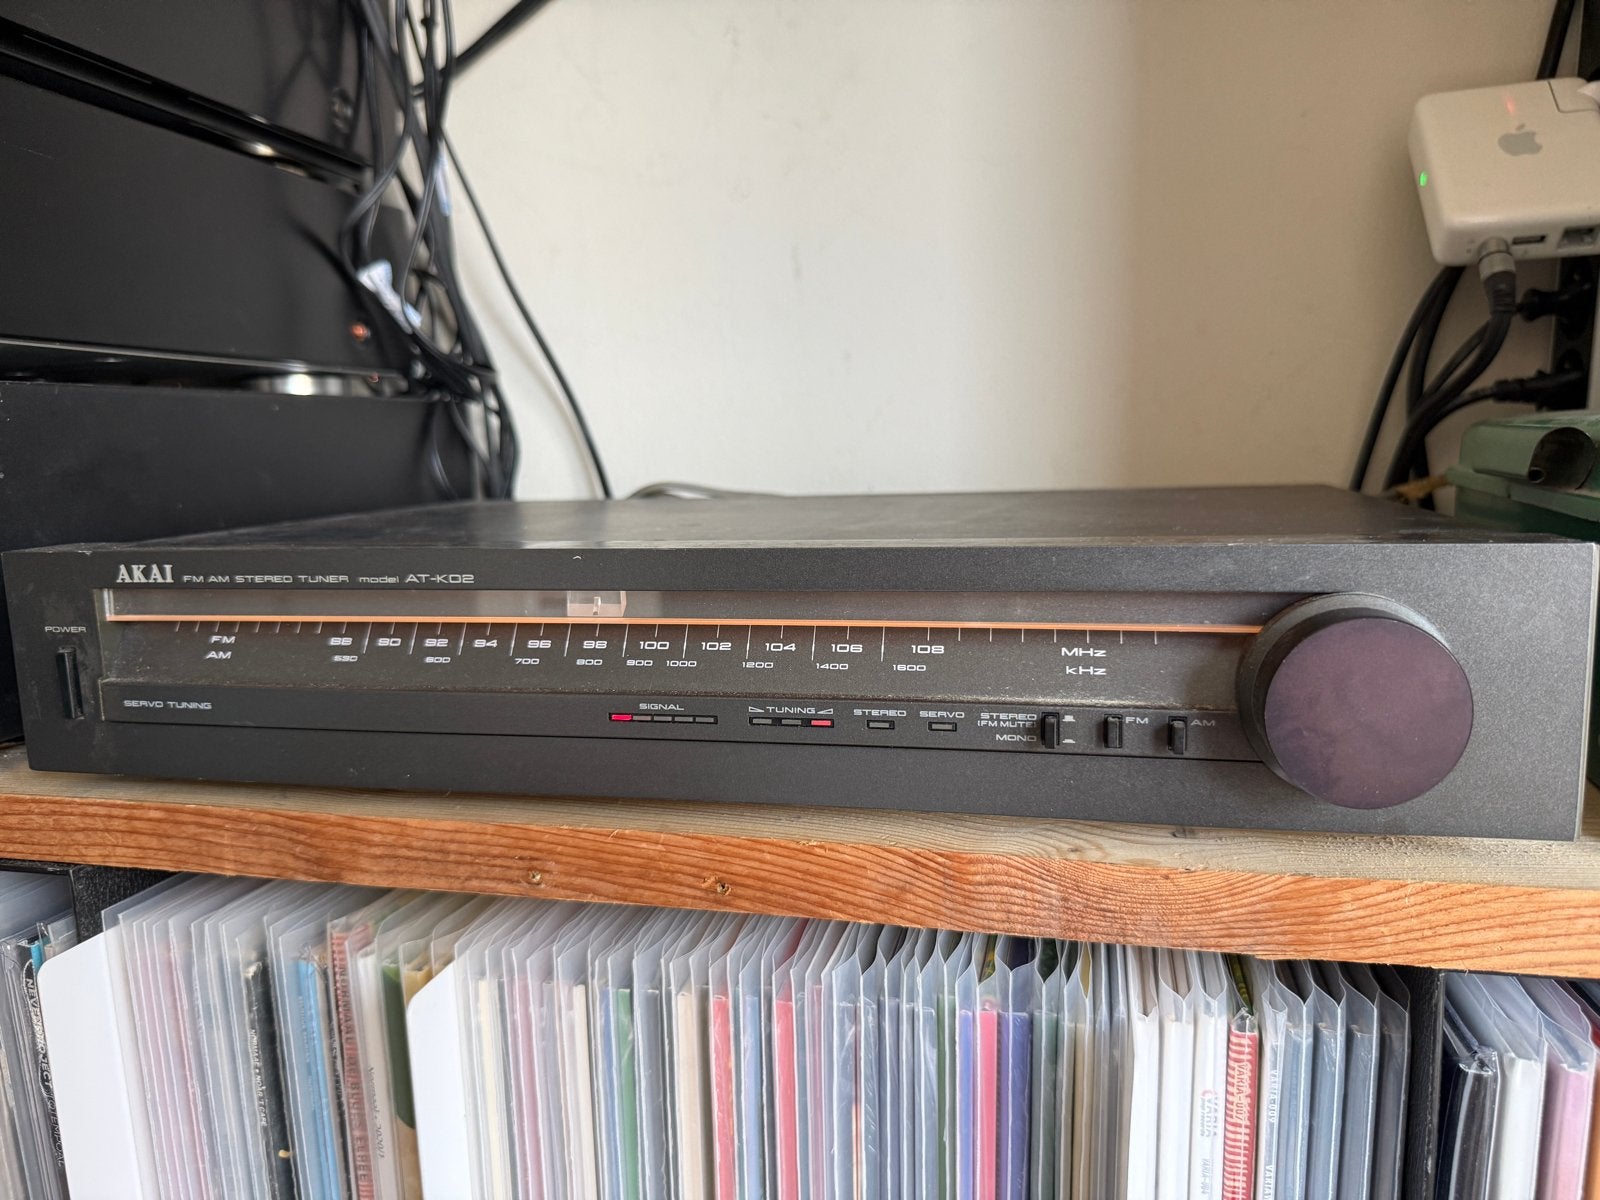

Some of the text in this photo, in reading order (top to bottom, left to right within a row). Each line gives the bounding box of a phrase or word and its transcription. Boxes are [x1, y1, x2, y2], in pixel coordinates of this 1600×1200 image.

[115, 563, 475, 584] AKAI FM AM STEREO TUNER model AT-K02
[44, 625, 87, 633] POWER
[210, 635, 1107, 657] FM 88 90 92 94 96 98 100 102 104 106 108 MHz
[205, 650, 232, 659] AM
[514, 657, 540, 665] 700
[576, 658, 603, 666] 800
[626, 659, 654, 667] 900
[666, 660, 697, 668] 1000
[742, 661, 774, 669] 1200
[816, 662, 849, 670] 1400
[892, 664, 927, 672] 1600
[1065, 665, 1107, 676] kHz
[123, 699, 213, 710] SERVO TUNING
[639, 702, 685, 711] SIGNAL
[765, 706, 816, 714] TUNING
[853, 708, 907, 717] STEREO
[919, 710, 965, 719] SERVO
[980, 712, 1037, 721] STEREO
[1125, 716, 1149, 724] FM
[1189, 718, 1215, 727] AM
[995, 733, 1038, 742] MONO
